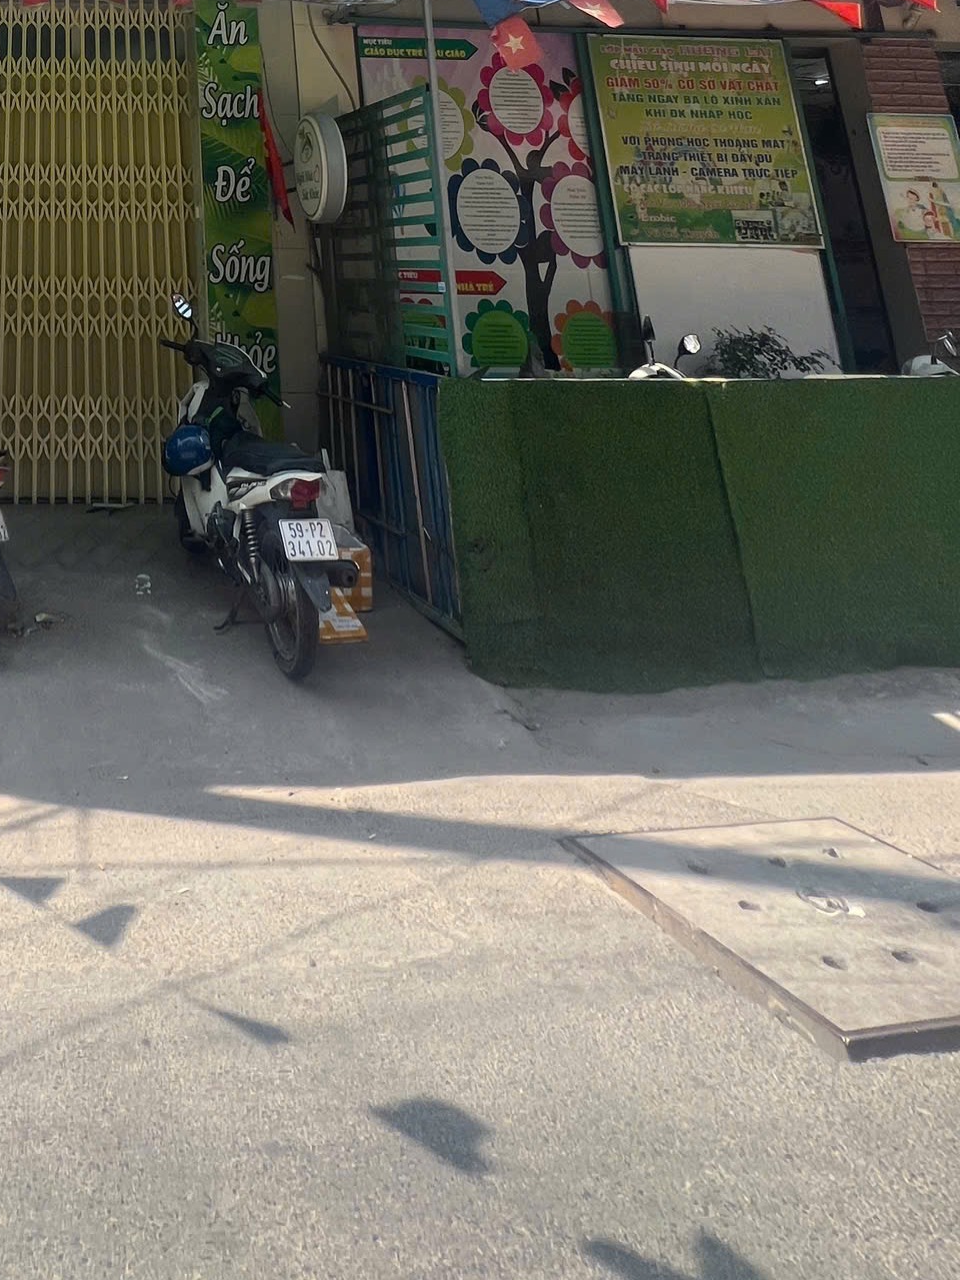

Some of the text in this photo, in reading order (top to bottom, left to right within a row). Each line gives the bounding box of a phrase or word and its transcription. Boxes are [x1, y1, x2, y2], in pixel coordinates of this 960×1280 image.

[207, 1, 249, 46] Ăn
[202, 81, 260, 127] Sạch
[644, 77, 673, 90] 50%
[214, 157, 257, 203] Để
[208, 241, 272, 293] Sống
[216, 331, 278, 374] ỏe
[288, 540, 333, 558] 341.02
[289, 522, 327, 539] 59-P2
